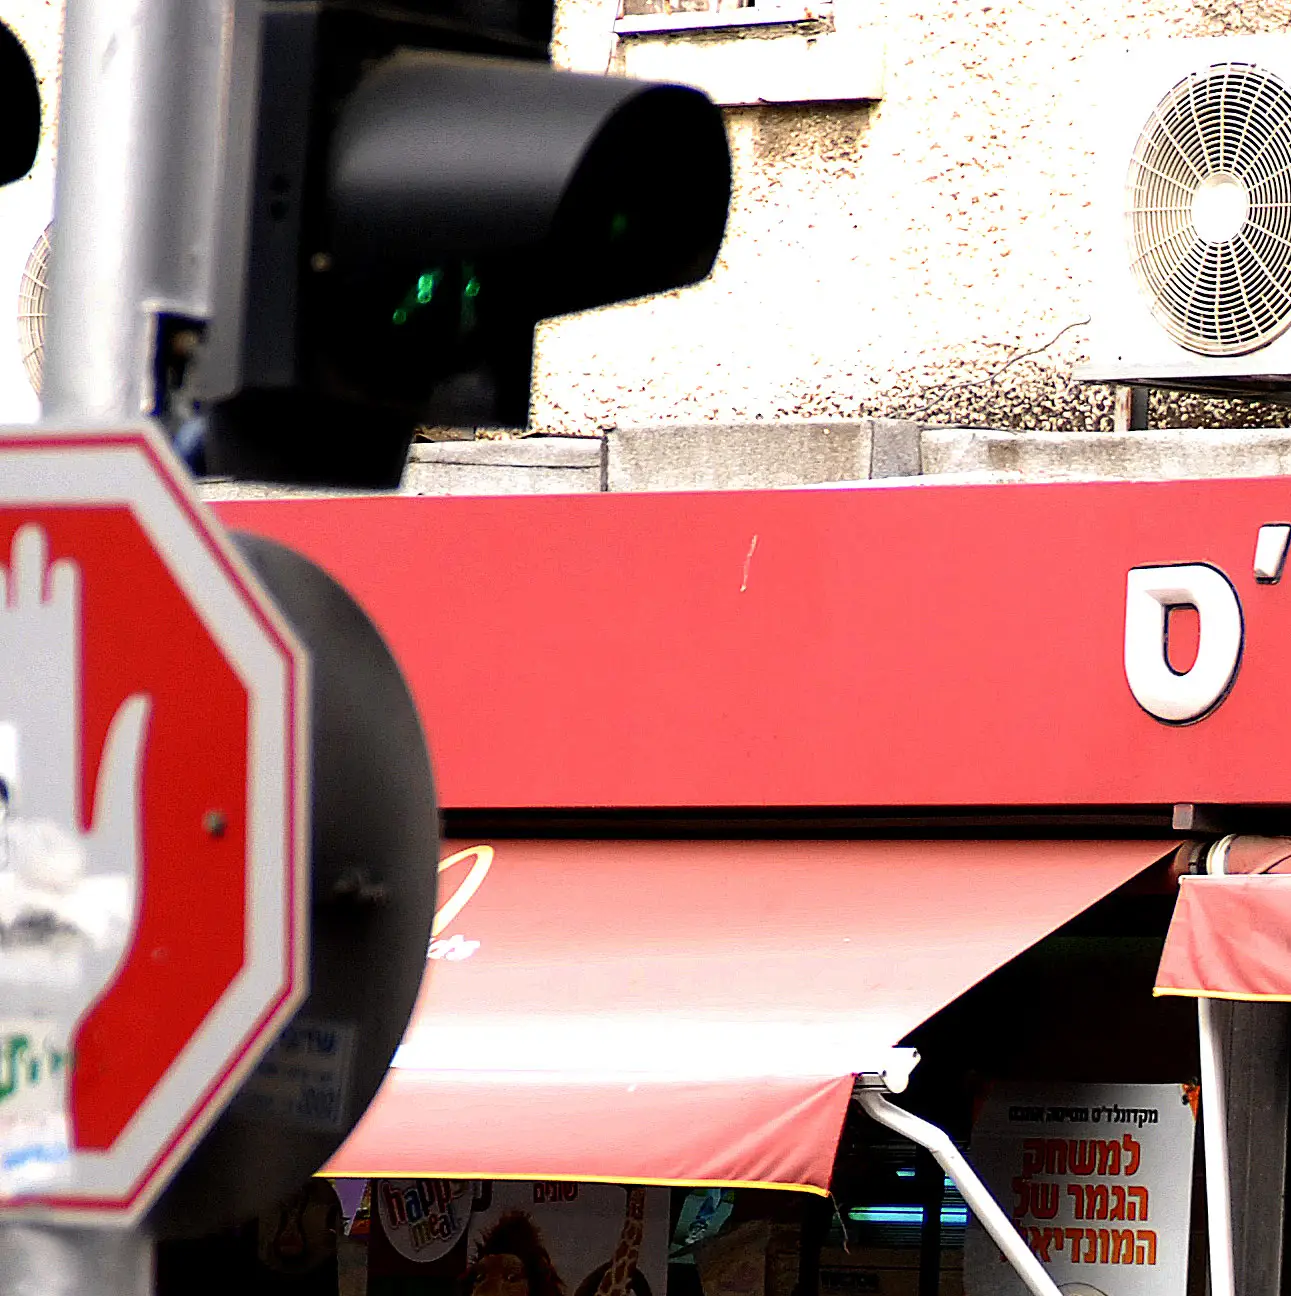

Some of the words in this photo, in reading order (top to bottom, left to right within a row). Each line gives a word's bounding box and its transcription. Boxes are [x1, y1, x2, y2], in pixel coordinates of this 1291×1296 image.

[1022, 1133, 1141, 1178] למשחק
[1012, 1176, 1060, 1220] של
[1067, 1183, 1149, 1221] הגמר
